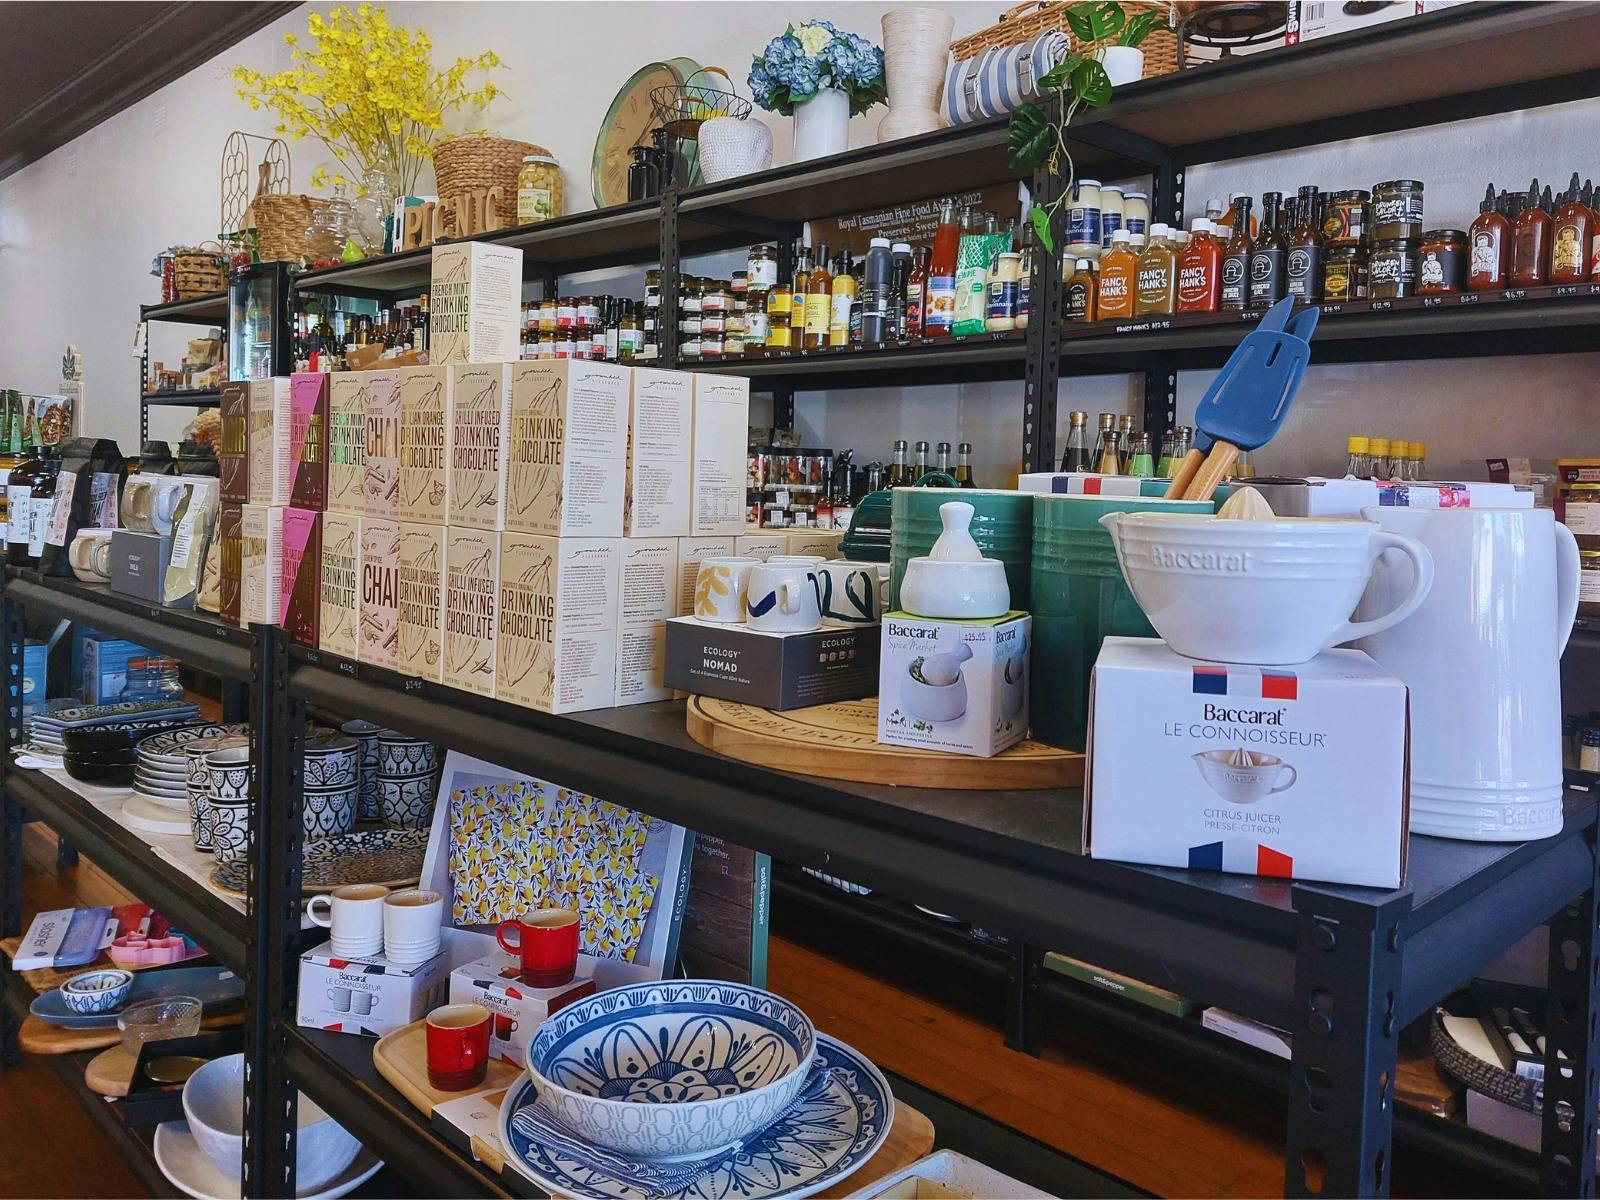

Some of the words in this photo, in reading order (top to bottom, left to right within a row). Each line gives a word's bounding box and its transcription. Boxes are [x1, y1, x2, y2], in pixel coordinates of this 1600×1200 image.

[838, 216, 857, 231] Royal
[858, 210, 894, 226] Tasmanian
[895, 207, 911, 220] Fine
[912, 202, 930, 216] Food
[964, 193, 983, 207] 2022
[878, 225, 911, 238] Preserves
[916, 221, 938, 232] Sweet
[1140, 269, 1166, 280] FANCY
[1180, 266, 1206, 278] FANCY
[432, 283, 452, 297] FRENCH
[453, 282, 469, 296] MINT
[1100, 286, 1128, 297] HANK'S
[1101, 277, 1127, 287] FANCY
[1138, 279, 1168, 290] HANK'S
[1179, 276, 1207, 288] HANK'S
[431, 296, 469, 314] DRINKING
[431, 314, 468, 333] CHOCOLATE
[350, 413, 366, 427] MINT
[422, 411, 444, 426] ORANGE
[455, 410, 474, 425] CHILLI
[475, 410, 500, 426] INFUSED
[366, 417, 398, 458] CHAI
[400, 427, 444, 446] DRINKING
[454, 427, 499, 447] DRINKING
[513, 417, 563, 440] DRINKING
[400, 447, 444, 469] CHOCOLATE
[453, 448, 498, 472] CHOCOLATE
[512, 440, 562, 465] CHOCOLATE
[323, 551, 341, 567] FRENCH
[341, 555, 356, 570] MINT
[1151, 546, 1252, 573] Baccarat
[322, 566, 356, 588] DRINKING
[400, 566, 418, 582] SICILIAN
[419, 569, 440, 587] ORANGE
[448, 572, 467, 590] CHILLI
[467, 576, 495, 595] INFUSED
[363, 564, 398, 609] CHAI
[400, 581, 440, 607] DRINKING
[321, 584, 356, 610] CHOCOLATE
[447, 588, 494, 617] DRINKING
[501, 588, 554, 619] DRINKING
[400, 601, 439, 630] CHOCOLATE
[446, 610, 493, 641] CHOCOLATE
[500, 610, 553, 644] CHOCOLATE
[888, 623, 940, 640] Baccarat
[822, 637, 855, 649] ECOLOGY
[996, 627, 1017, 644] Baccarat
[703, 646, 739, 658] ECOLOGY
[887, 638, 906, 653] Spice
[908, 640, 937, 652] Market
[703, 658, 738, 673] NOMAD
[1203, 703, 1287, 726] Baccarat
[1164, 723, 1182, 738] LE
[1189, 724, 1325, 748] CONNOISSEUR
[1203, 808, 1243, 821] CITRUS
[1245, 811, 1282, 824] JUICER
[1203, 820, 1280, 835] PRESSE-CITRON
[675, 868, 689, 921] ECOLOGY
[759, 867, 767, 926] salt&pepper
[339, 972, 367, 984] Baccarat
[484, 992, 509, 1007] Baccarat
